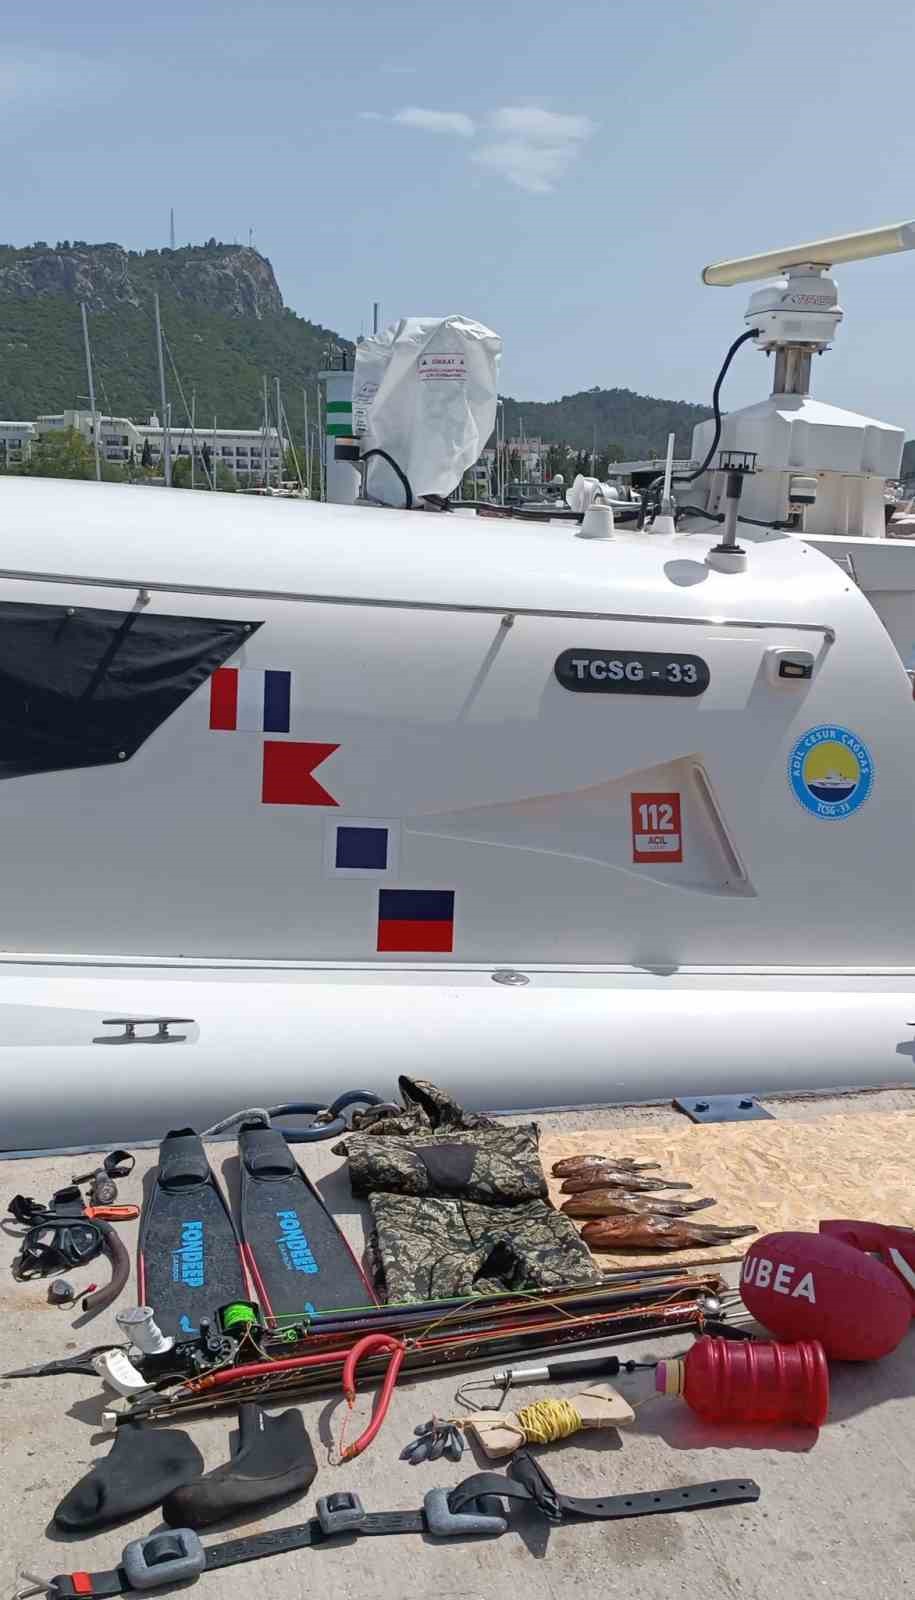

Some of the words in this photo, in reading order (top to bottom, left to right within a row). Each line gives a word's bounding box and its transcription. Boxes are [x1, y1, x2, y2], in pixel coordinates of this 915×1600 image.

[572, 659, 643, 681] TCSG
[667, 663, 698, 683] 33
[804, 731, 836, 747] CESUR
[639, 803, 674, 831] 112
[172, 1221, 204, 1287] FONDEEP
[276, 1211, 320, 1274] FONDEEP
